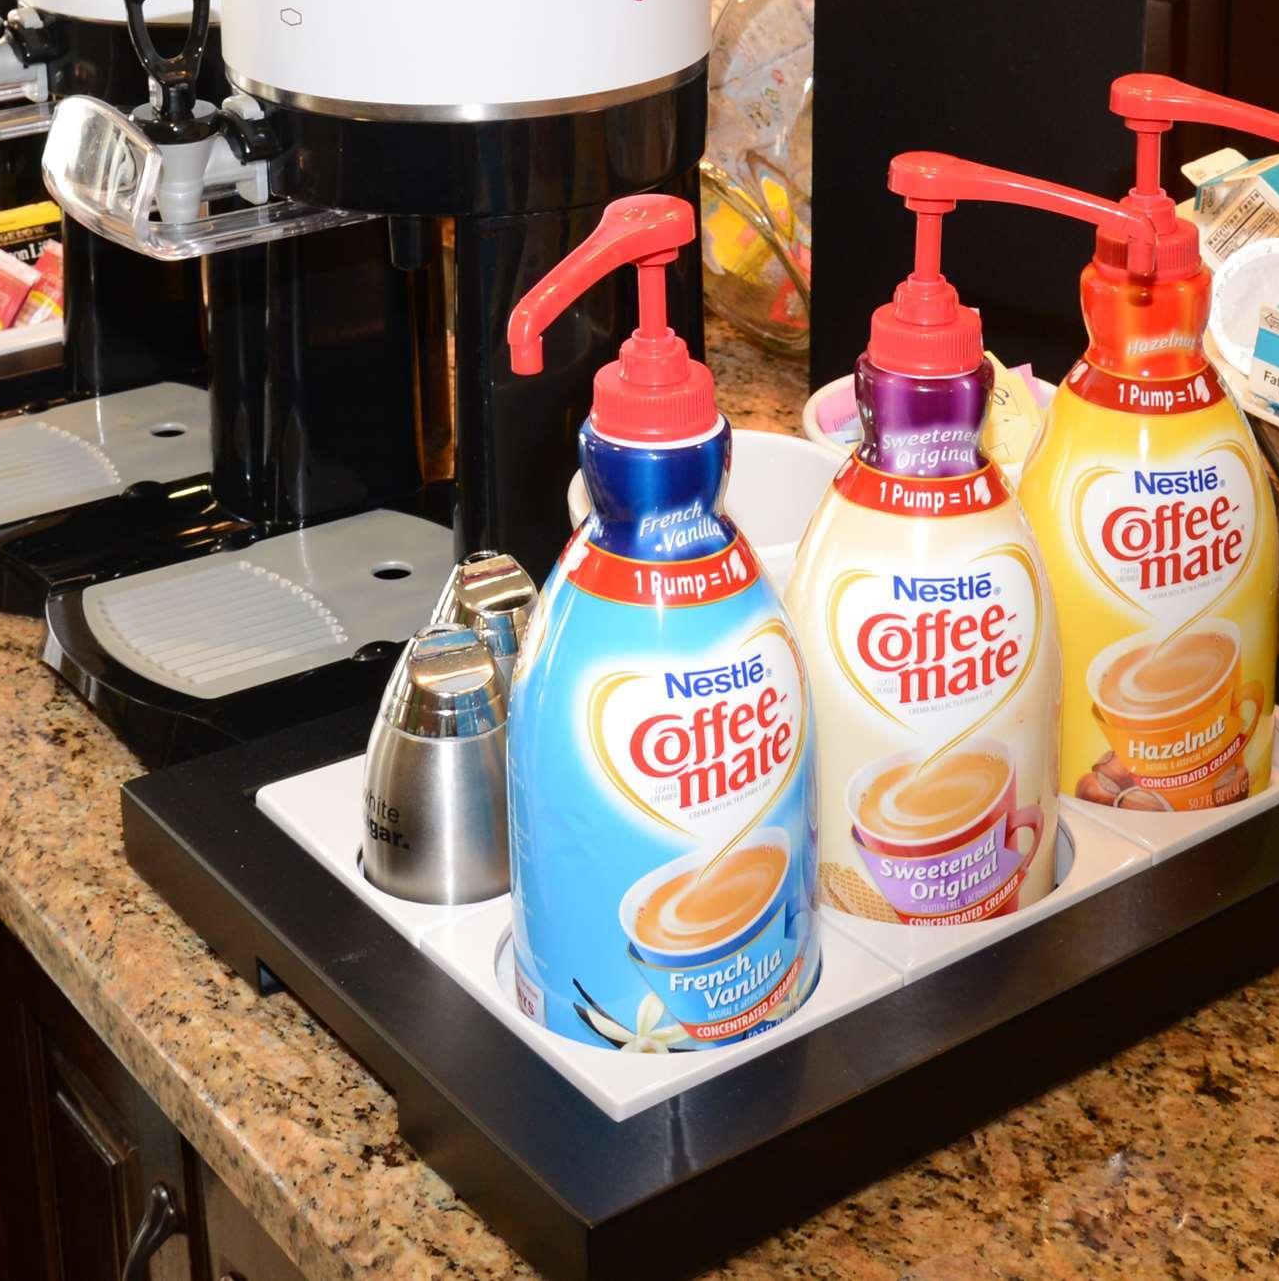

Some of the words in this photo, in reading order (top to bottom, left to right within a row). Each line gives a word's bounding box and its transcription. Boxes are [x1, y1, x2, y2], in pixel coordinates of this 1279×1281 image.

[1127, 333, 1195, 355] Hazelnut
[1118, 383, 1125, 403] 1
[1130, 384, 1174, 412] Pump
[882, 429, 980, 450] Sweetened
[896, 445, 976, 469] Original
[880, 482, 886, 502] 1
[892, 483, 945, 513] Pump
[963, 483, 972, 505] 1
[1134, 466, 1218, 495] Nestlé
[640, 500, 702, 537] French
[663, 517, 726, 552] Vanilla
[1140, 529, 1242, 590] mate
[634, 570, 643, 594] 1
[650, 570, 707, 599] Pump
[721, 560, 732, 584] 1
[893, 572, 992, 602] Nestlé
[664, 653, 764, 699] Nestlé
[899, 639, 1018, 703] mate
[1128, 715, 1225, 760] Hazelnut
[677, 722, 791, 809] mate
[1140, 766, 1208, 788] CONCENTRATED
[1210, 738, 1240, 771] CREAMER
[880, 830, 996, 880] Sweetened
[910, 851, 999, 900] Original
[909, 906, 983, 926] CONCENTRATED
[984, 874, 1019, 912] CREAMER
[670, 953, 751, 991] French
[704, 948, 783, 1009] Vanilla
[697, 1001, 768, 1038] CONCENTRATED
